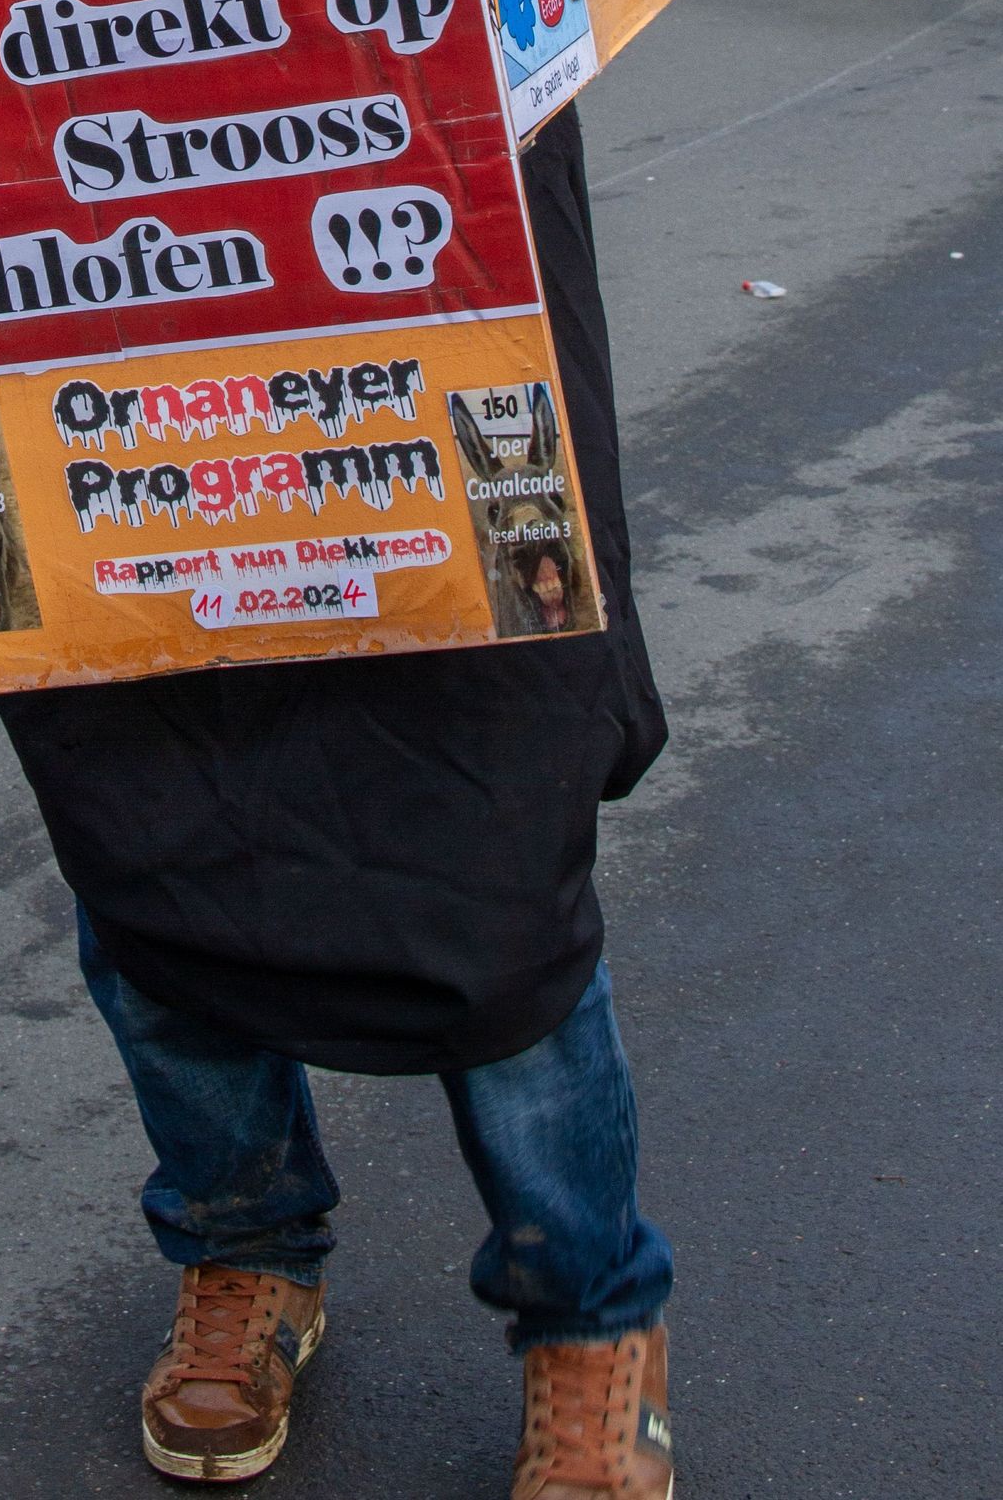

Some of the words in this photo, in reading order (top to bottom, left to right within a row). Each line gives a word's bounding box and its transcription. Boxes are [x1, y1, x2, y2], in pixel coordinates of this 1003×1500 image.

[530, 86, 544, 107] Der
[562, 53, 580, 81] Vogel
[63, 98, 403, 191] Strooss
[329, 200, 443, 286] !!?
[55, 359, 424, 451] Ornaneyer
[482, 394, 518, 421] 150
[490, 437, 531, 459] Joer
[66, 438, 444, 532] Programm
[466, 469, 565, 500] Cavalcade
[523, 522, 560, 541] heich
[563, 521, 572, 538] 3
[96, 550, 222, 591] Rapport
[231, 547, 288, 579] vun
[297, 531, 448, 572] Diekkrech
